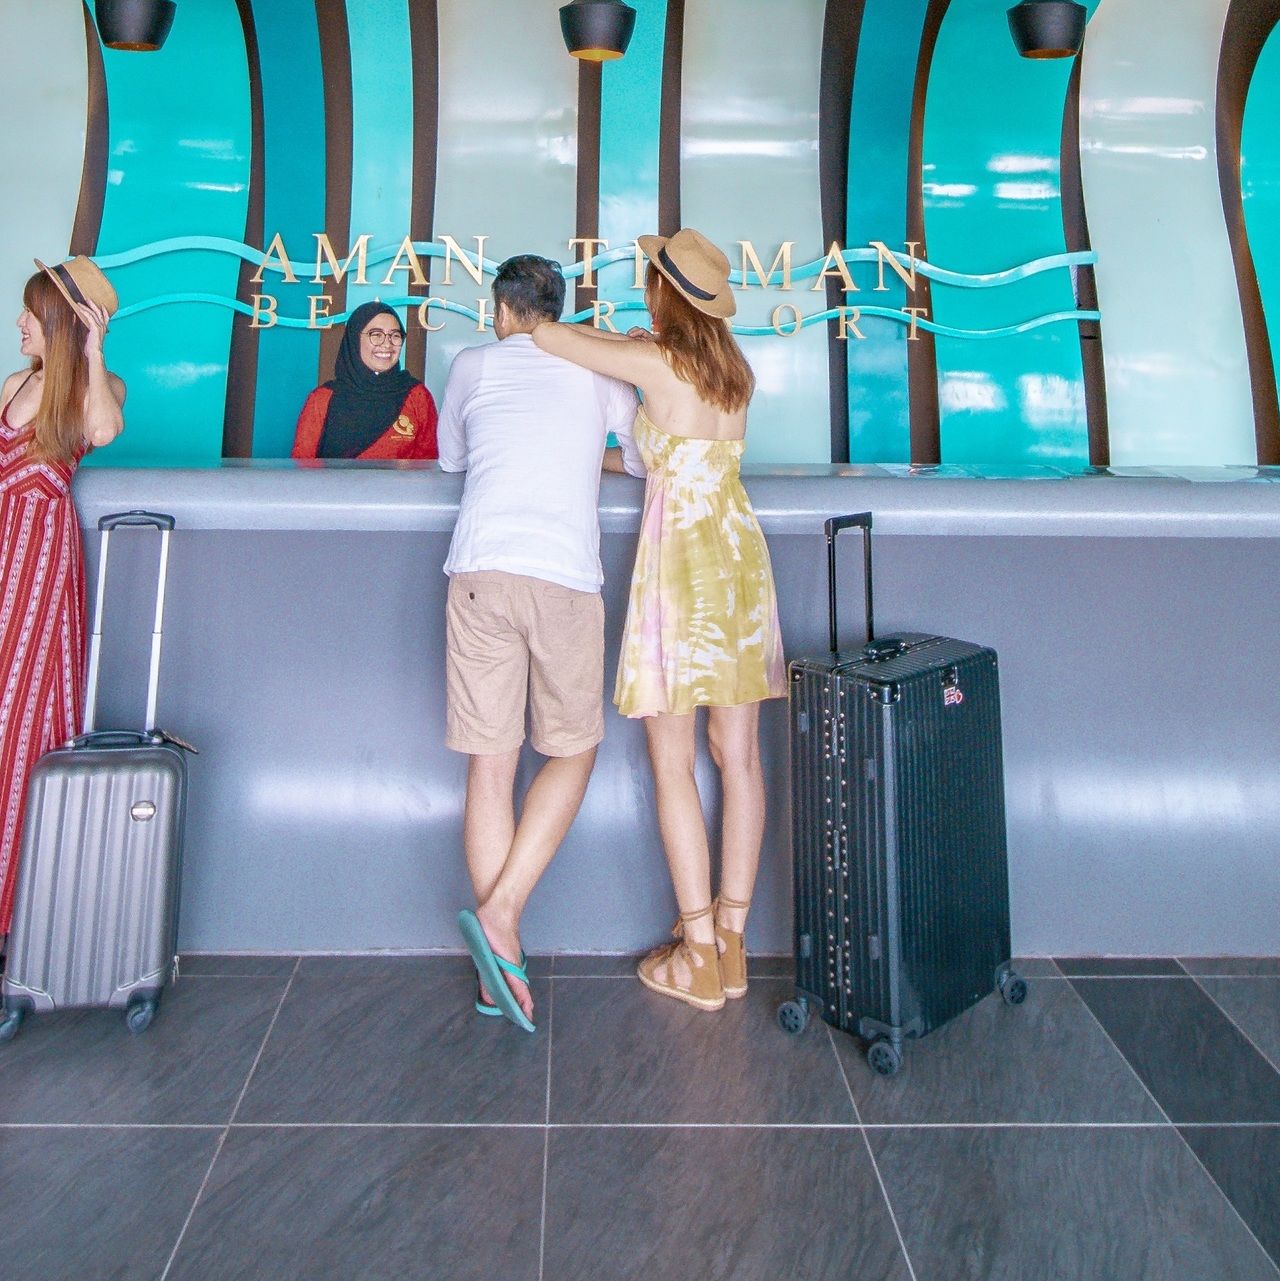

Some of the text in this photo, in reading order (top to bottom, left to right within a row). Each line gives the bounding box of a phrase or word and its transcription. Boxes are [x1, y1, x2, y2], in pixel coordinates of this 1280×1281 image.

[250, 232, 921, 292] AMAN TIMAN
[590, 300, 928, 341] RORT
